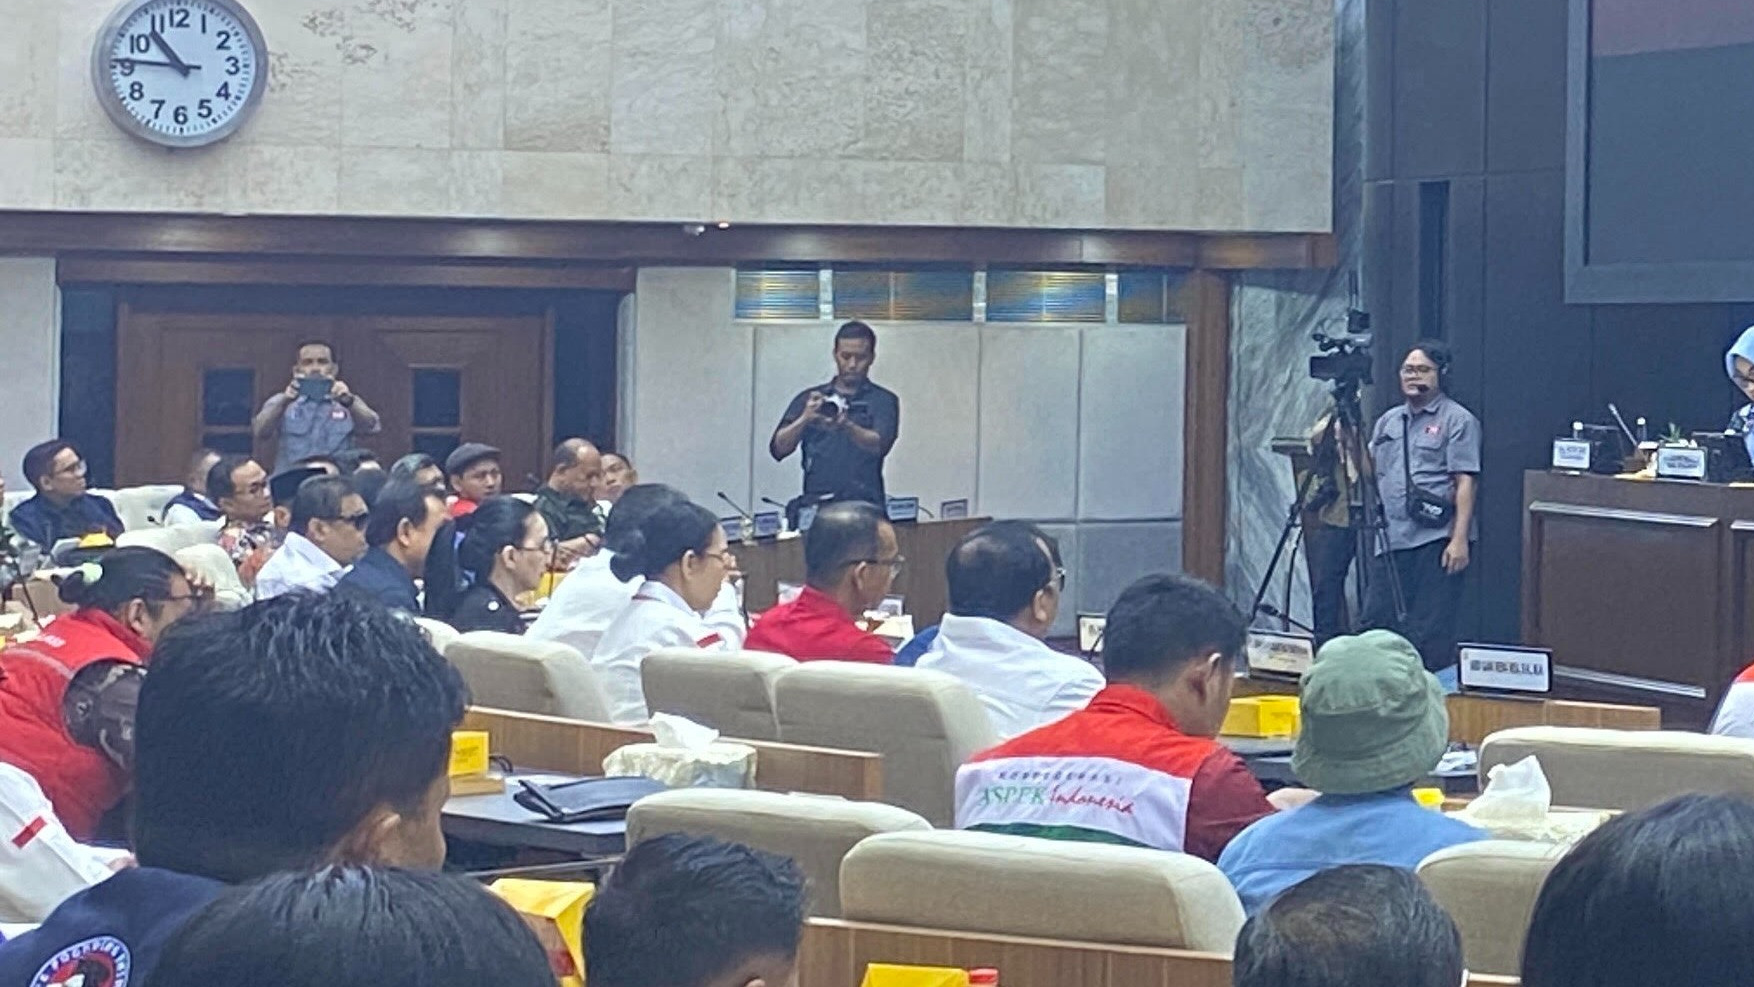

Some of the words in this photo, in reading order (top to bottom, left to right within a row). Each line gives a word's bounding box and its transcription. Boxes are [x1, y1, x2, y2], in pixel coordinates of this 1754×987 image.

[168, 8, 191, 28] 12
[201, 14, 206, 34] 1
[129, 33, 151, 54] 10
[216, 30, 232, 51] 2
[119, 57, 135, 77] 9
[225, 56, 240, 75] 3
[129, 81, 144, 101] 8
[215, 81, 231, 101] 4
[150, 99, 166, 119] 7
[172, 106, 188, 125] 6
[197, 99, 213, 119] 5
